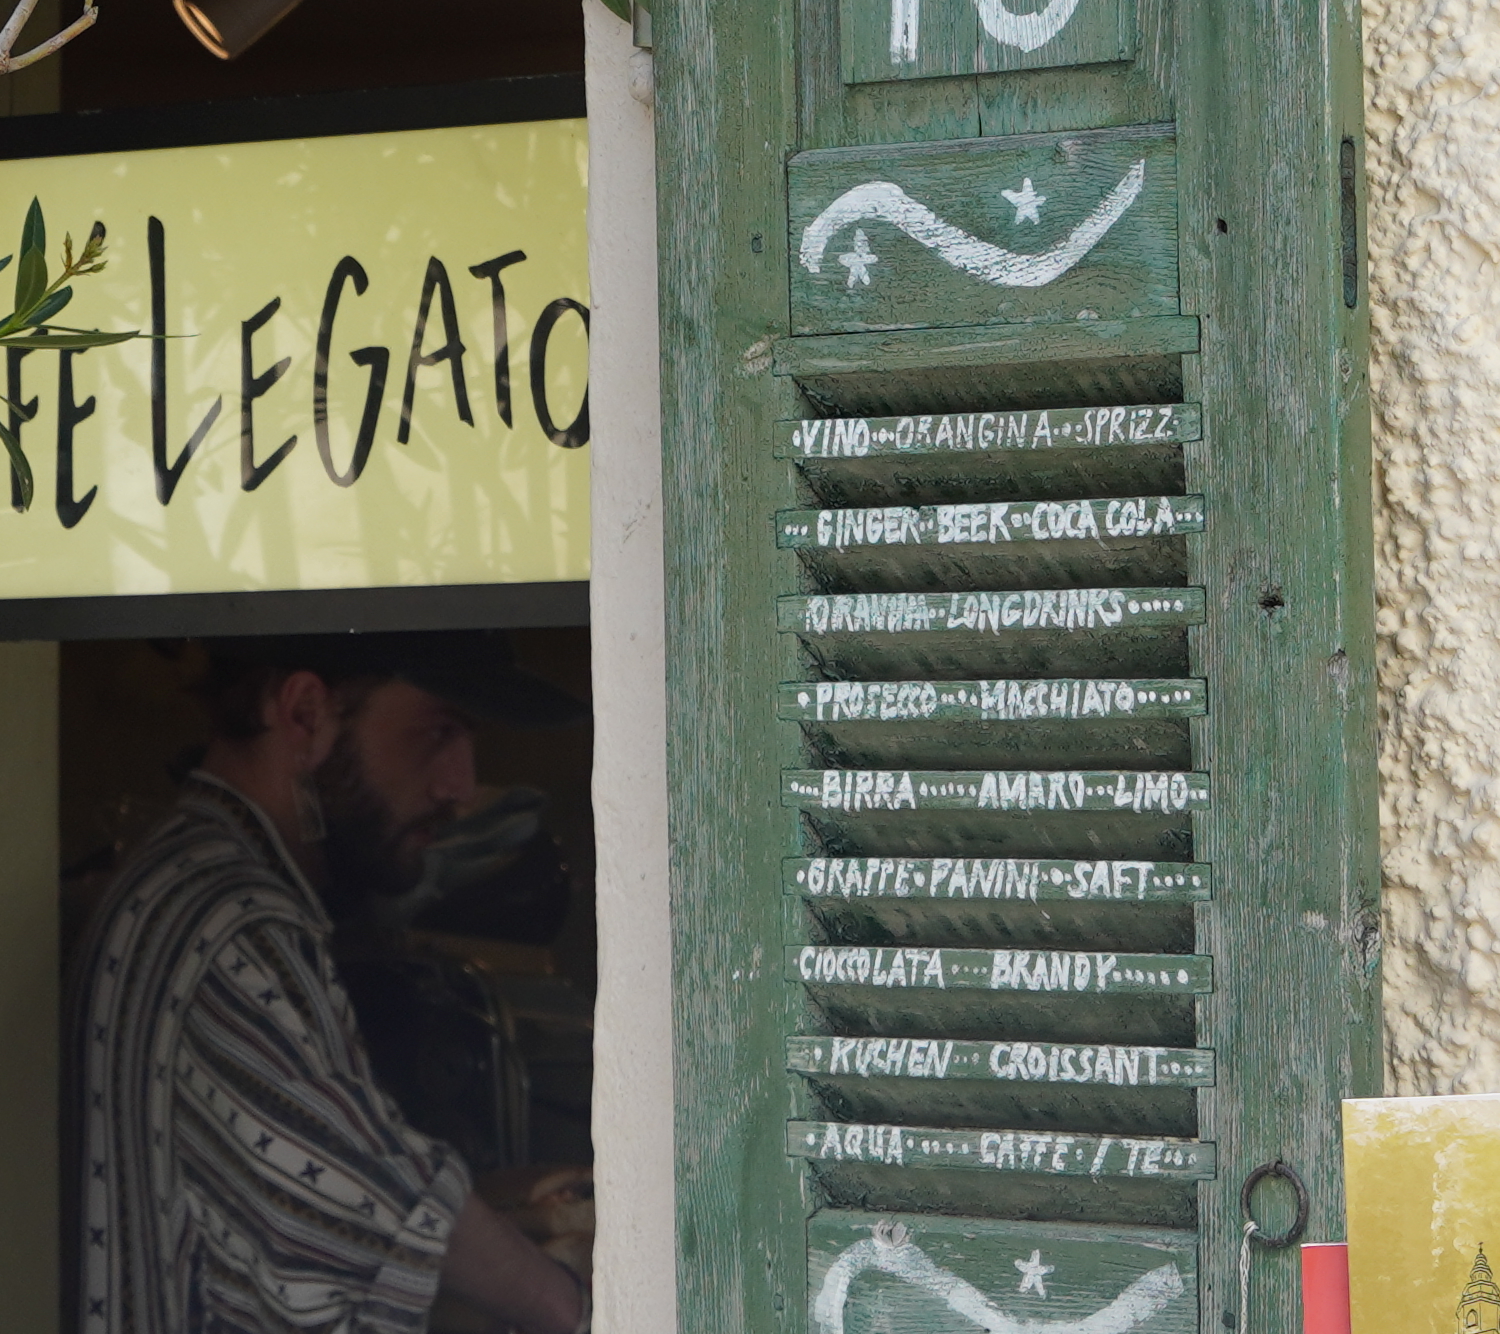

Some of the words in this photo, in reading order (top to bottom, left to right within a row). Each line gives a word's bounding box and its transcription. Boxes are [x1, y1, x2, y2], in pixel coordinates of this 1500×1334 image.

[801, 419, 868, 457] VINO
[895, 411, 1053, 450] ORANGINA
[817, 506, 921, 550] GINGER
[938, 504, 1011, 544] BEER
[1031, 500, 1099, 541] COCA
[1106, 496, 1175, 536] COLA
[981, 679, 1134, 720] MACCHIATO
[821, 770, 916, 812] BIRRA
[977, 772, 1085, 811] AMARO
[1112, 773, 1188, 814] LIMO
[930, 859, 1039, 900] PANINI
[1067, 861, 1154, 899] SAFT
[799, 946, 945, 989] CIOCCOLATA
[991, 949, 1117, 992] BRANDY
[829, 1037, 953, 1078] KUCHEN
[988, 1044, 1167, 1085] CROISSANT
[820, 1123, 904, 1166] AQUA
